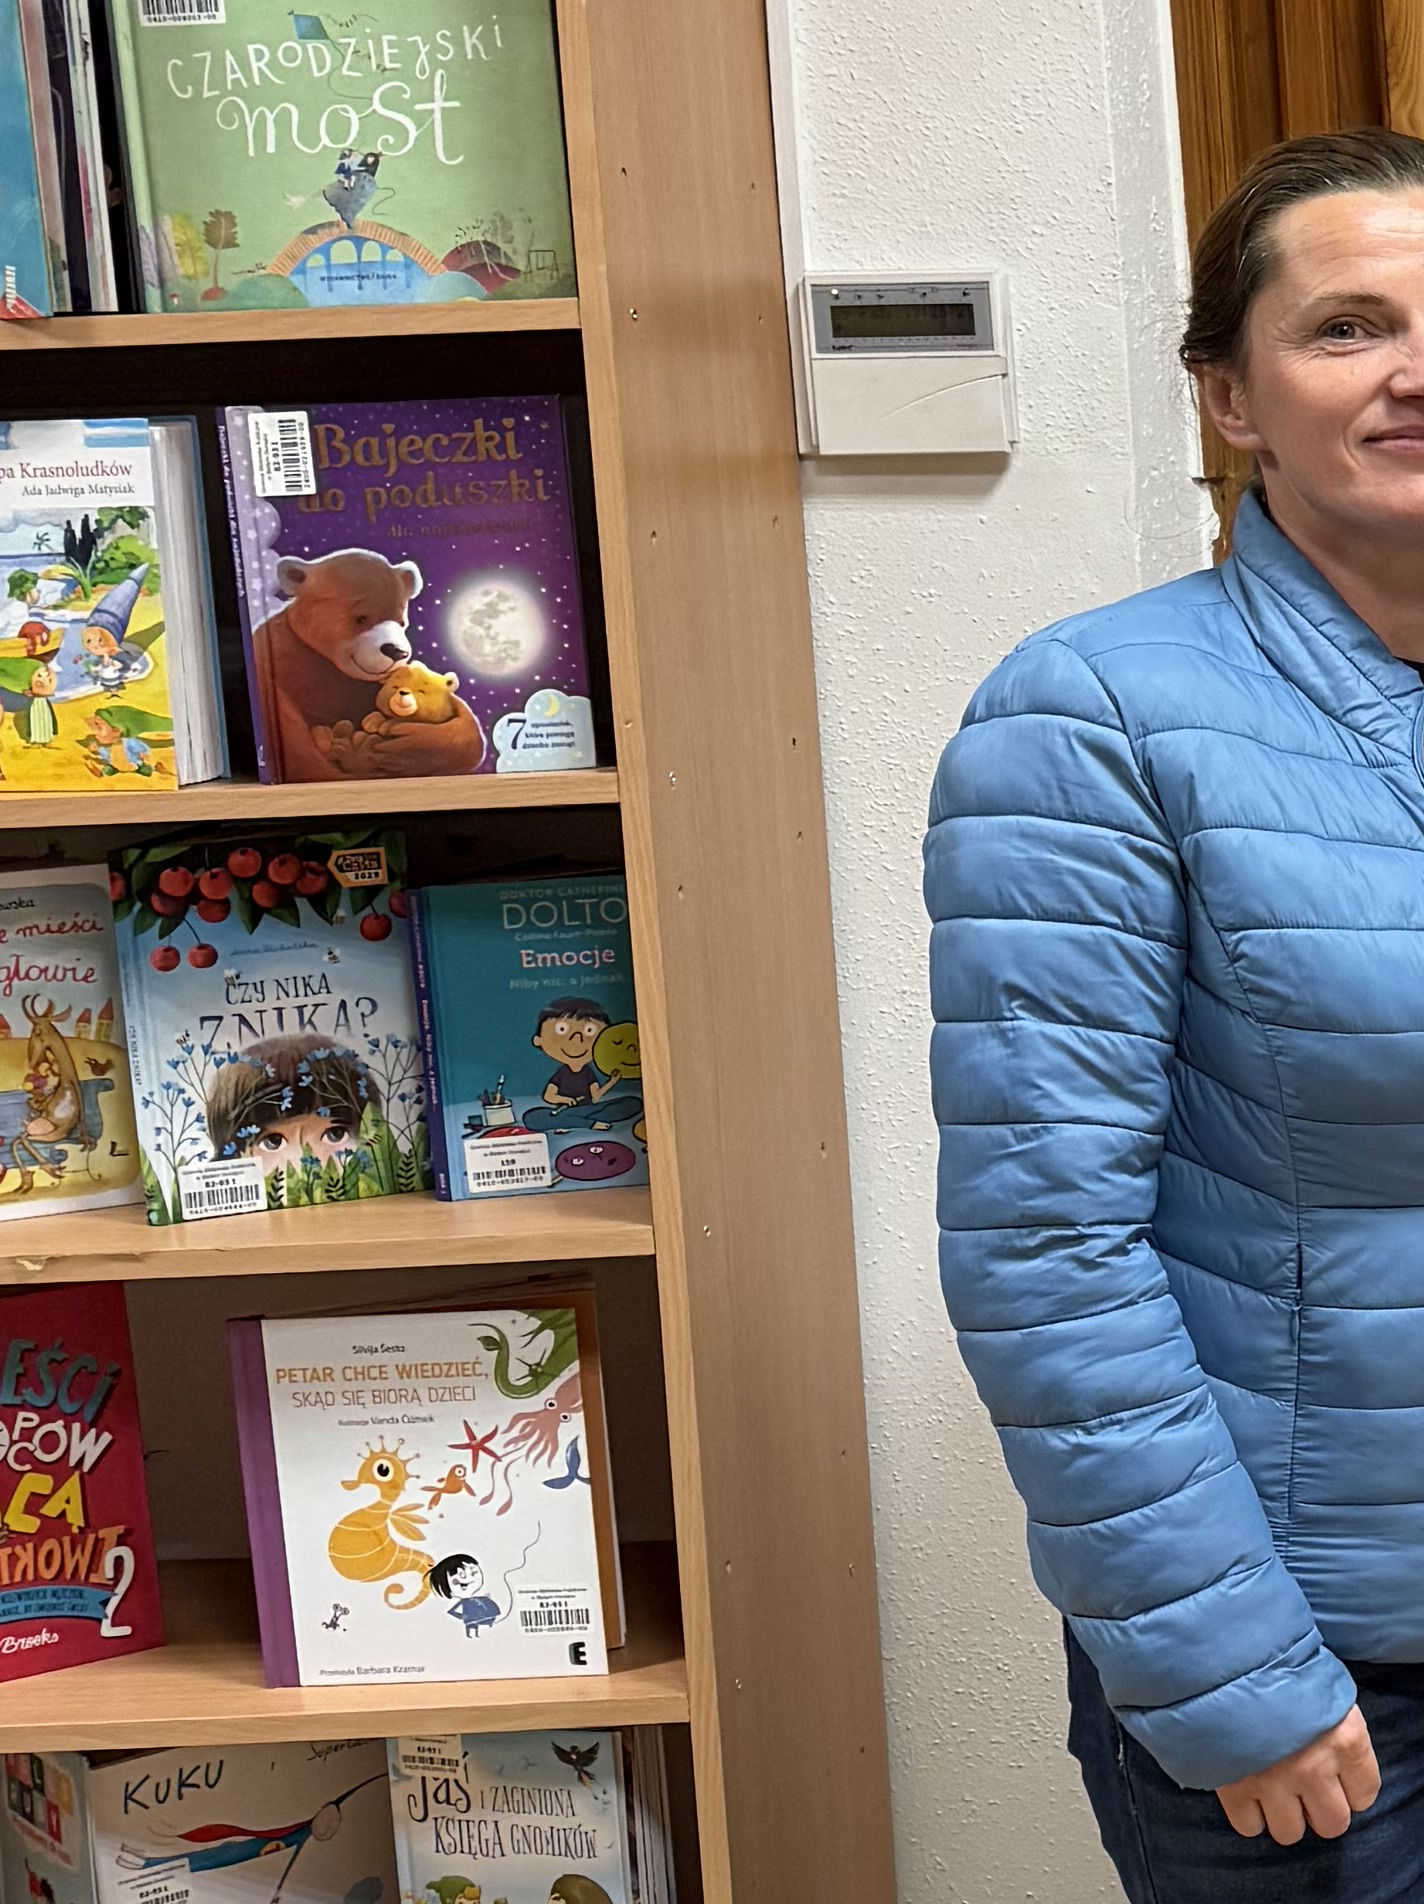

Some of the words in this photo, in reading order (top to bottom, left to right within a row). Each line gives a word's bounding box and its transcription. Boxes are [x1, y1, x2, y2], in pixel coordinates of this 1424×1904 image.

[167, 14, 503, 99] CZARODZIEJSKI
[313, 417, 523, 478] Bajeczki
[19, 460, 132, 479] Krasnoludków
[22, 486, 42, 496] Ada
[364, 469, 550, 524] poduszki
[507, 718, 527, 751] 7
[15, 911, 105, 938] mieści
[502, 897, 627, 930] DOLTO
[0, 954, 99, 998] głowie
[520, 944, 616, 969] Emocje
[225, 979, 266, 1006] CZY
[272, 972, 333, 1001] NIKA
[0, 1337, 120, 1424] EŚCI
[275, 1367, 336, 1385] PETAR
[341, 1364, 389, 1382] CHCE
[395, 1355, 490, 1380] WIEDZIEĆ,
[292, 1390, 336, 1411] SKĄD
[342, 1389, 368, 1409] SIĘ
[371, 1386, 423, 1407] BIORĄ
[428, 1385, 477, 1404] DZIECI
[0, 1472, 86, 1534] CĄ
[100, 1545, 135, 1638] 2
[0, 1627, 59, 1654] Brooks
[123, 1759, 224, 1815] KUKU
[407, 1751, 471, 1823] Jaś
[489, 1785, 577, 1818] ZAGINIONA
[431, 1815, 507, 1861] KSIĘGA
